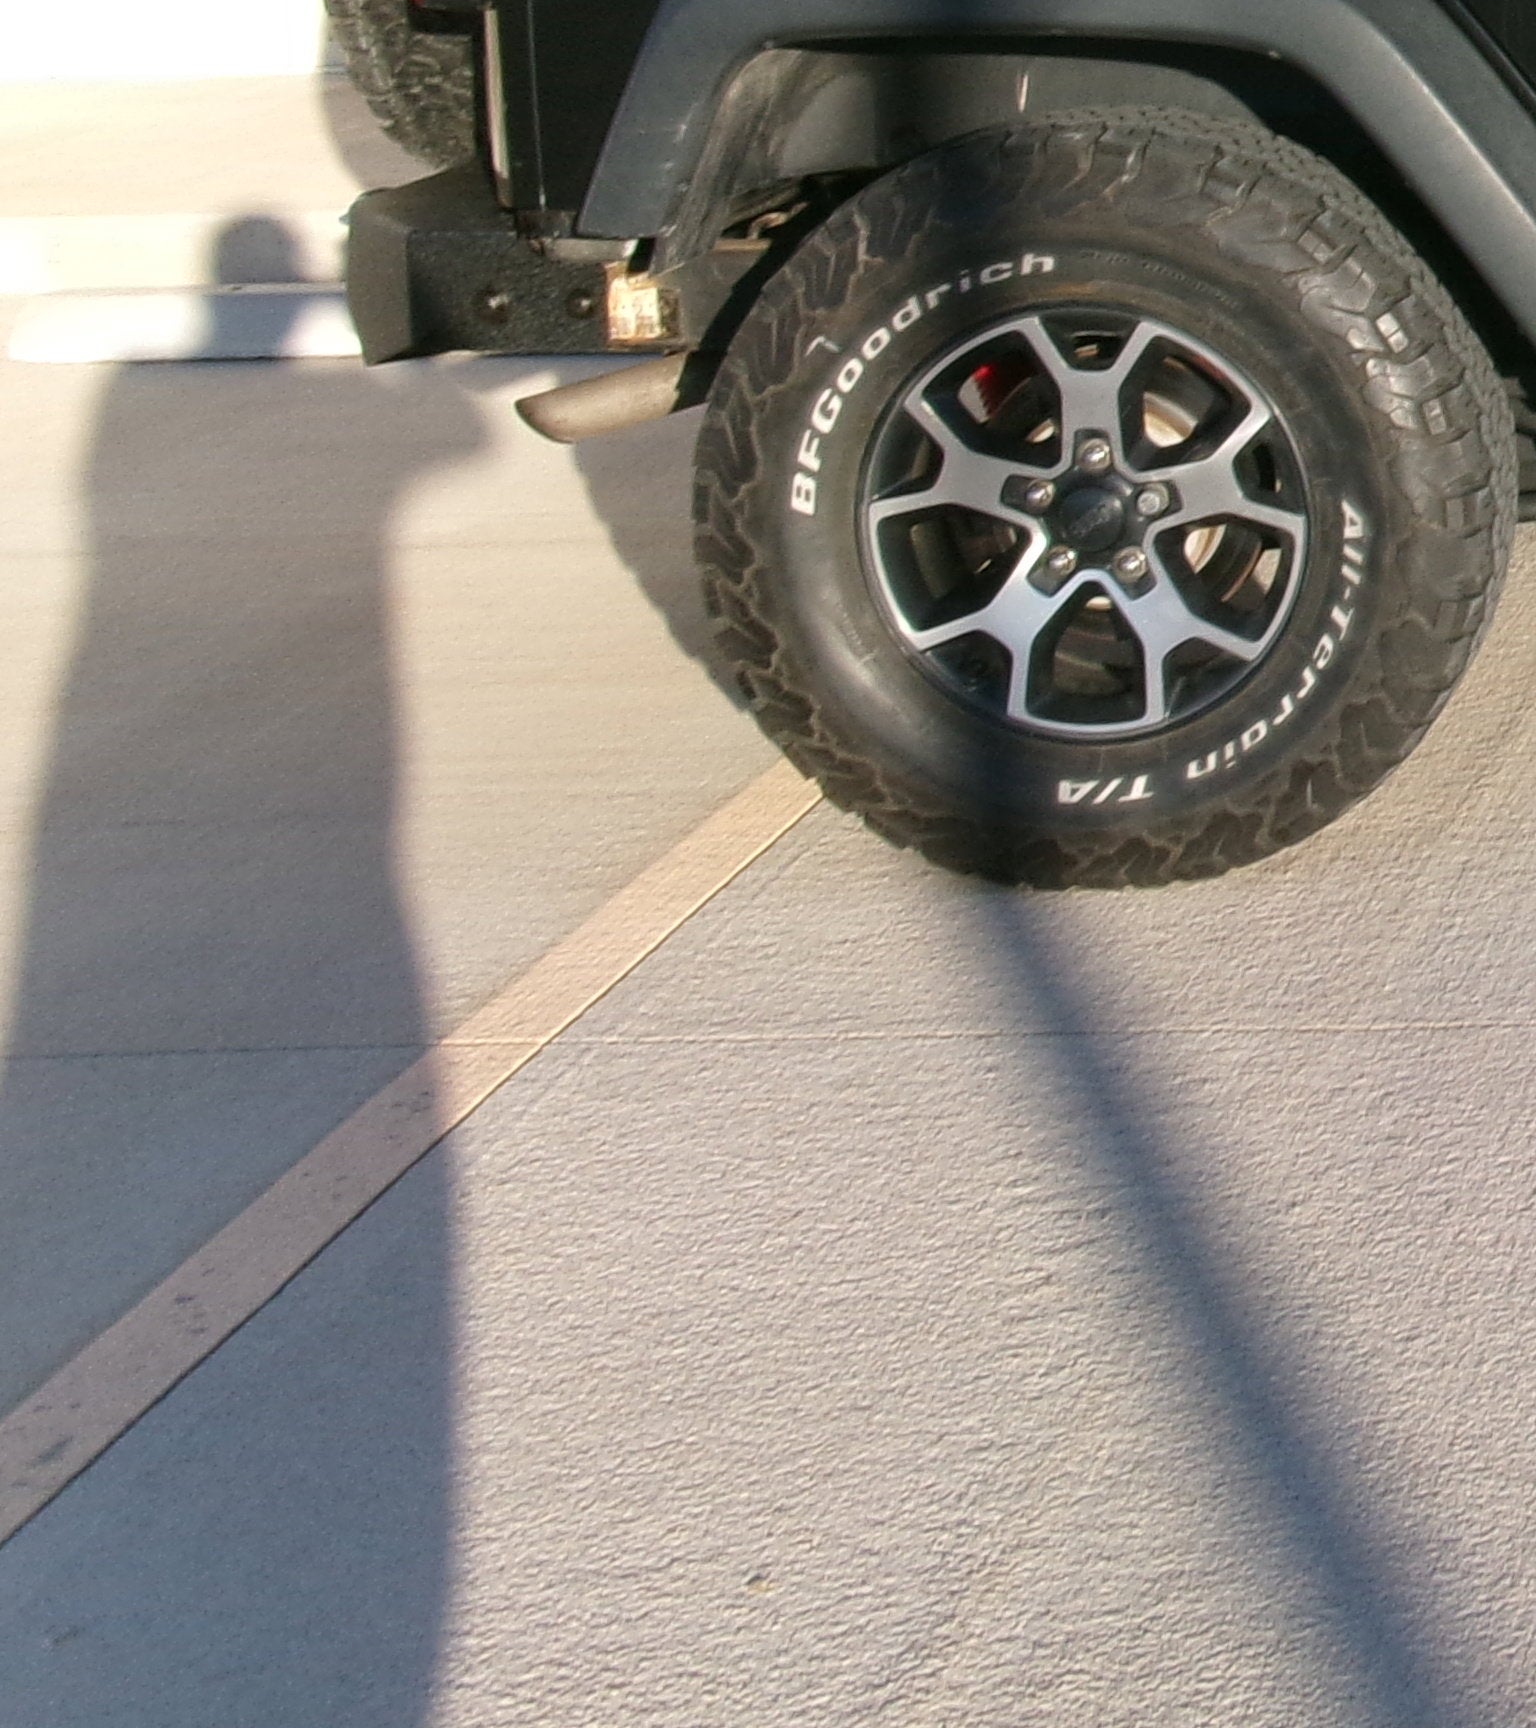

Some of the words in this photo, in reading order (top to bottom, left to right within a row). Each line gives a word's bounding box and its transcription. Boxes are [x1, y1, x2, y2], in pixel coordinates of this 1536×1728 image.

[790, 252, 1055, 516] BFGoodrich
[1187, 501, 1371, 780] All-Terrain
[1056, 773, 1157, 807] T/A
